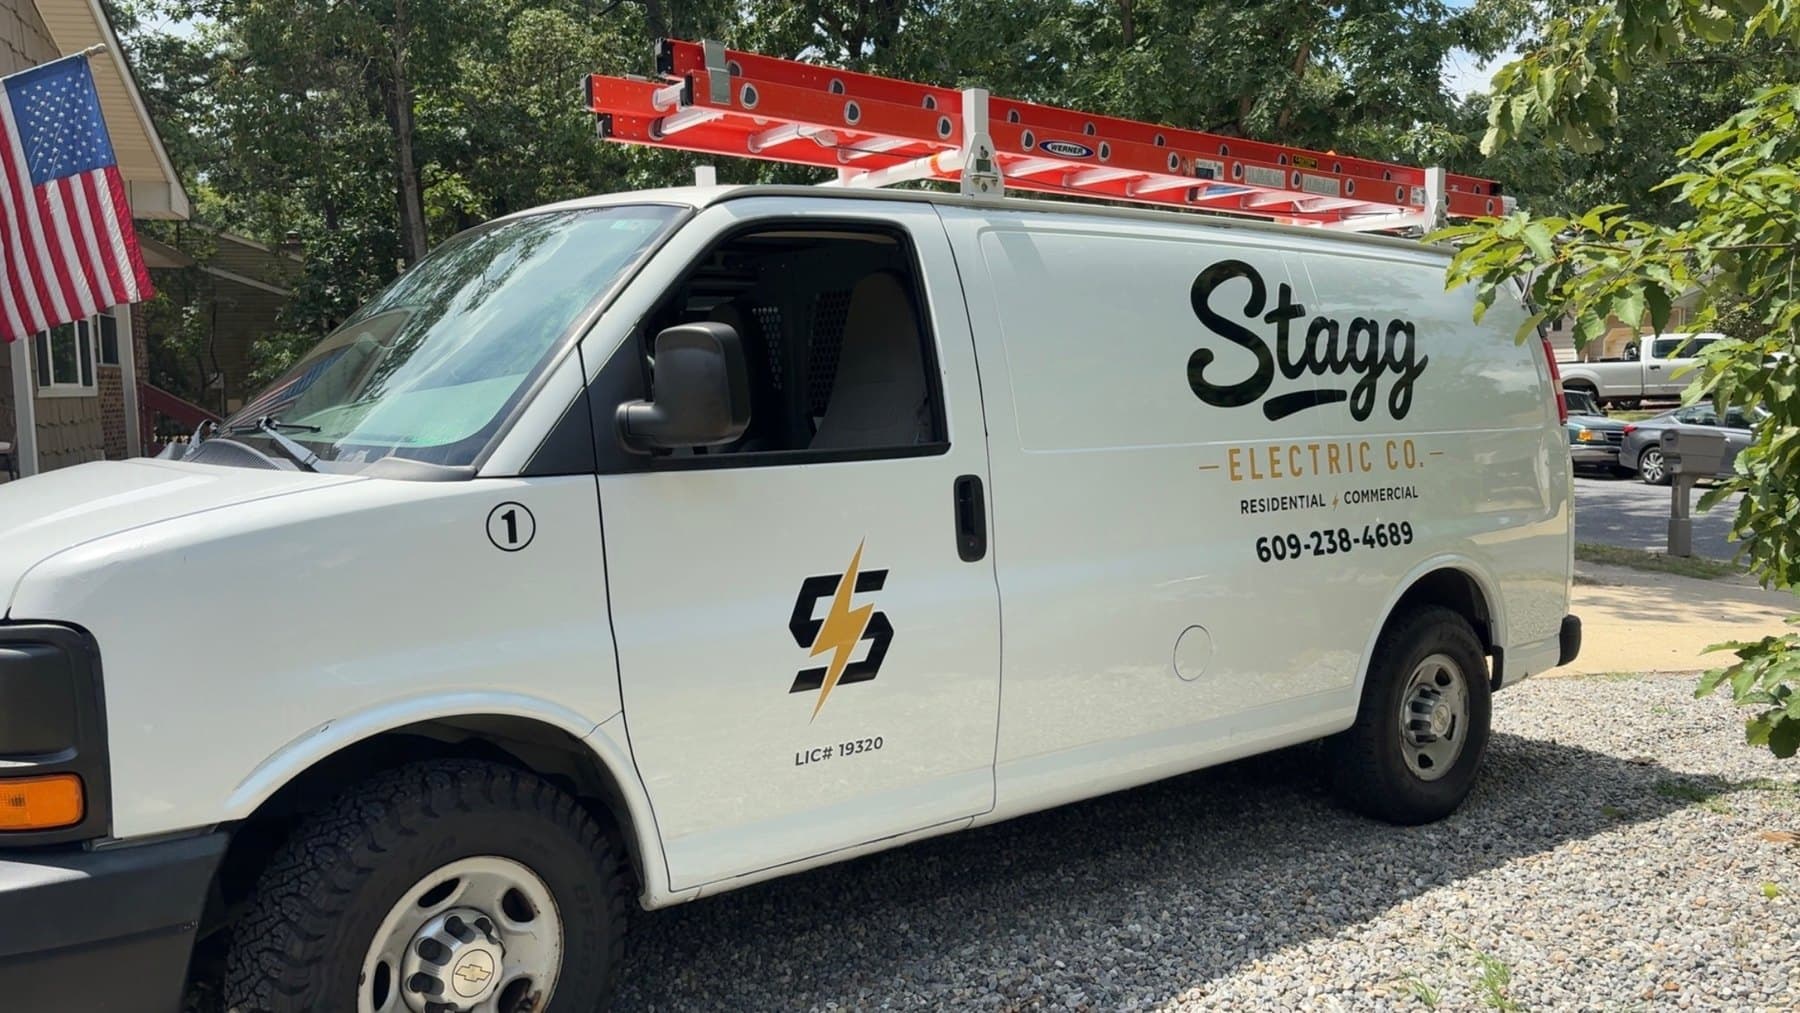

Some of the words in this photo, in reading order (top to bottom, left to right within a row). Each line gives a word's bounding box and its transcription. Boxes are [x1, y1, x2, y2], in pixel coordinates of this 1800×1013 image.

[1050, 143, 1084, 155] WERNER
[1187, 259, 1429, 422] Stagg
[1227, 442, 1373, 481] ELECTRIC
[1386, 439, 1424, 471] CO.
[1240, 493, 1326, 515] RESIDENTIAL
[1343, 485, 1419, 506] COMMERCIAL
[501, 509, 518, 544] 1
[1256, 520, 1414, 563] 609-238-4689
[795, 745, 833, 766] LIC#
[838, 736, 884, 757] 19320
